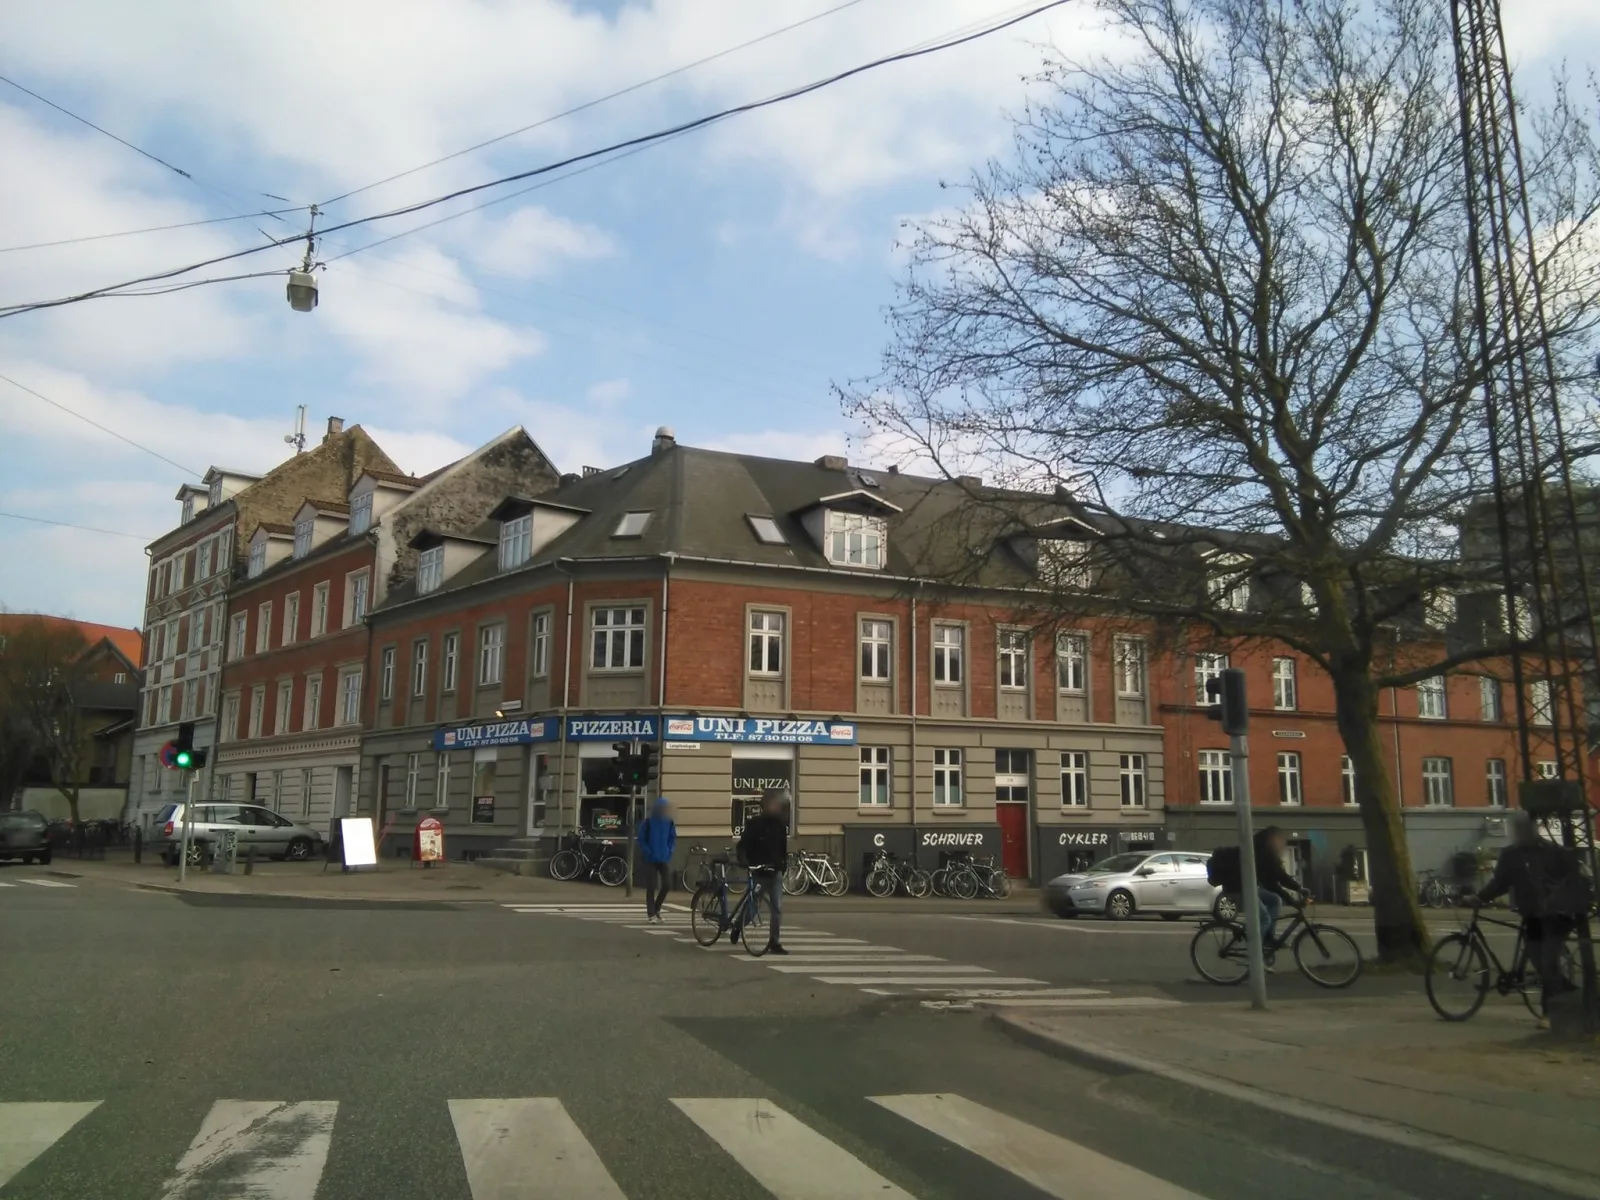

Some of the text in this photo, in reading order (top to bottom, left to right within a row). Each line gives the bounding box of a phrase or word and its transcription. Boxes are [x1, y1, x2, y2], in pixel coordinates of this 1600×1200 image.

[457, 726, 483, 740] UNI
[485, 721, 529, 738] PIZZA
[570, 720, 654, 736] PIZZERIA
[696, 717, 829, 736] UNI PIZZA
[733, 777, 791, 789] UNI PIZZA
[873, 833, 885, 847] C
[922, 832, 984, 846] SCHRIVER
[1059, 832, 1108, 845] CYKLER
